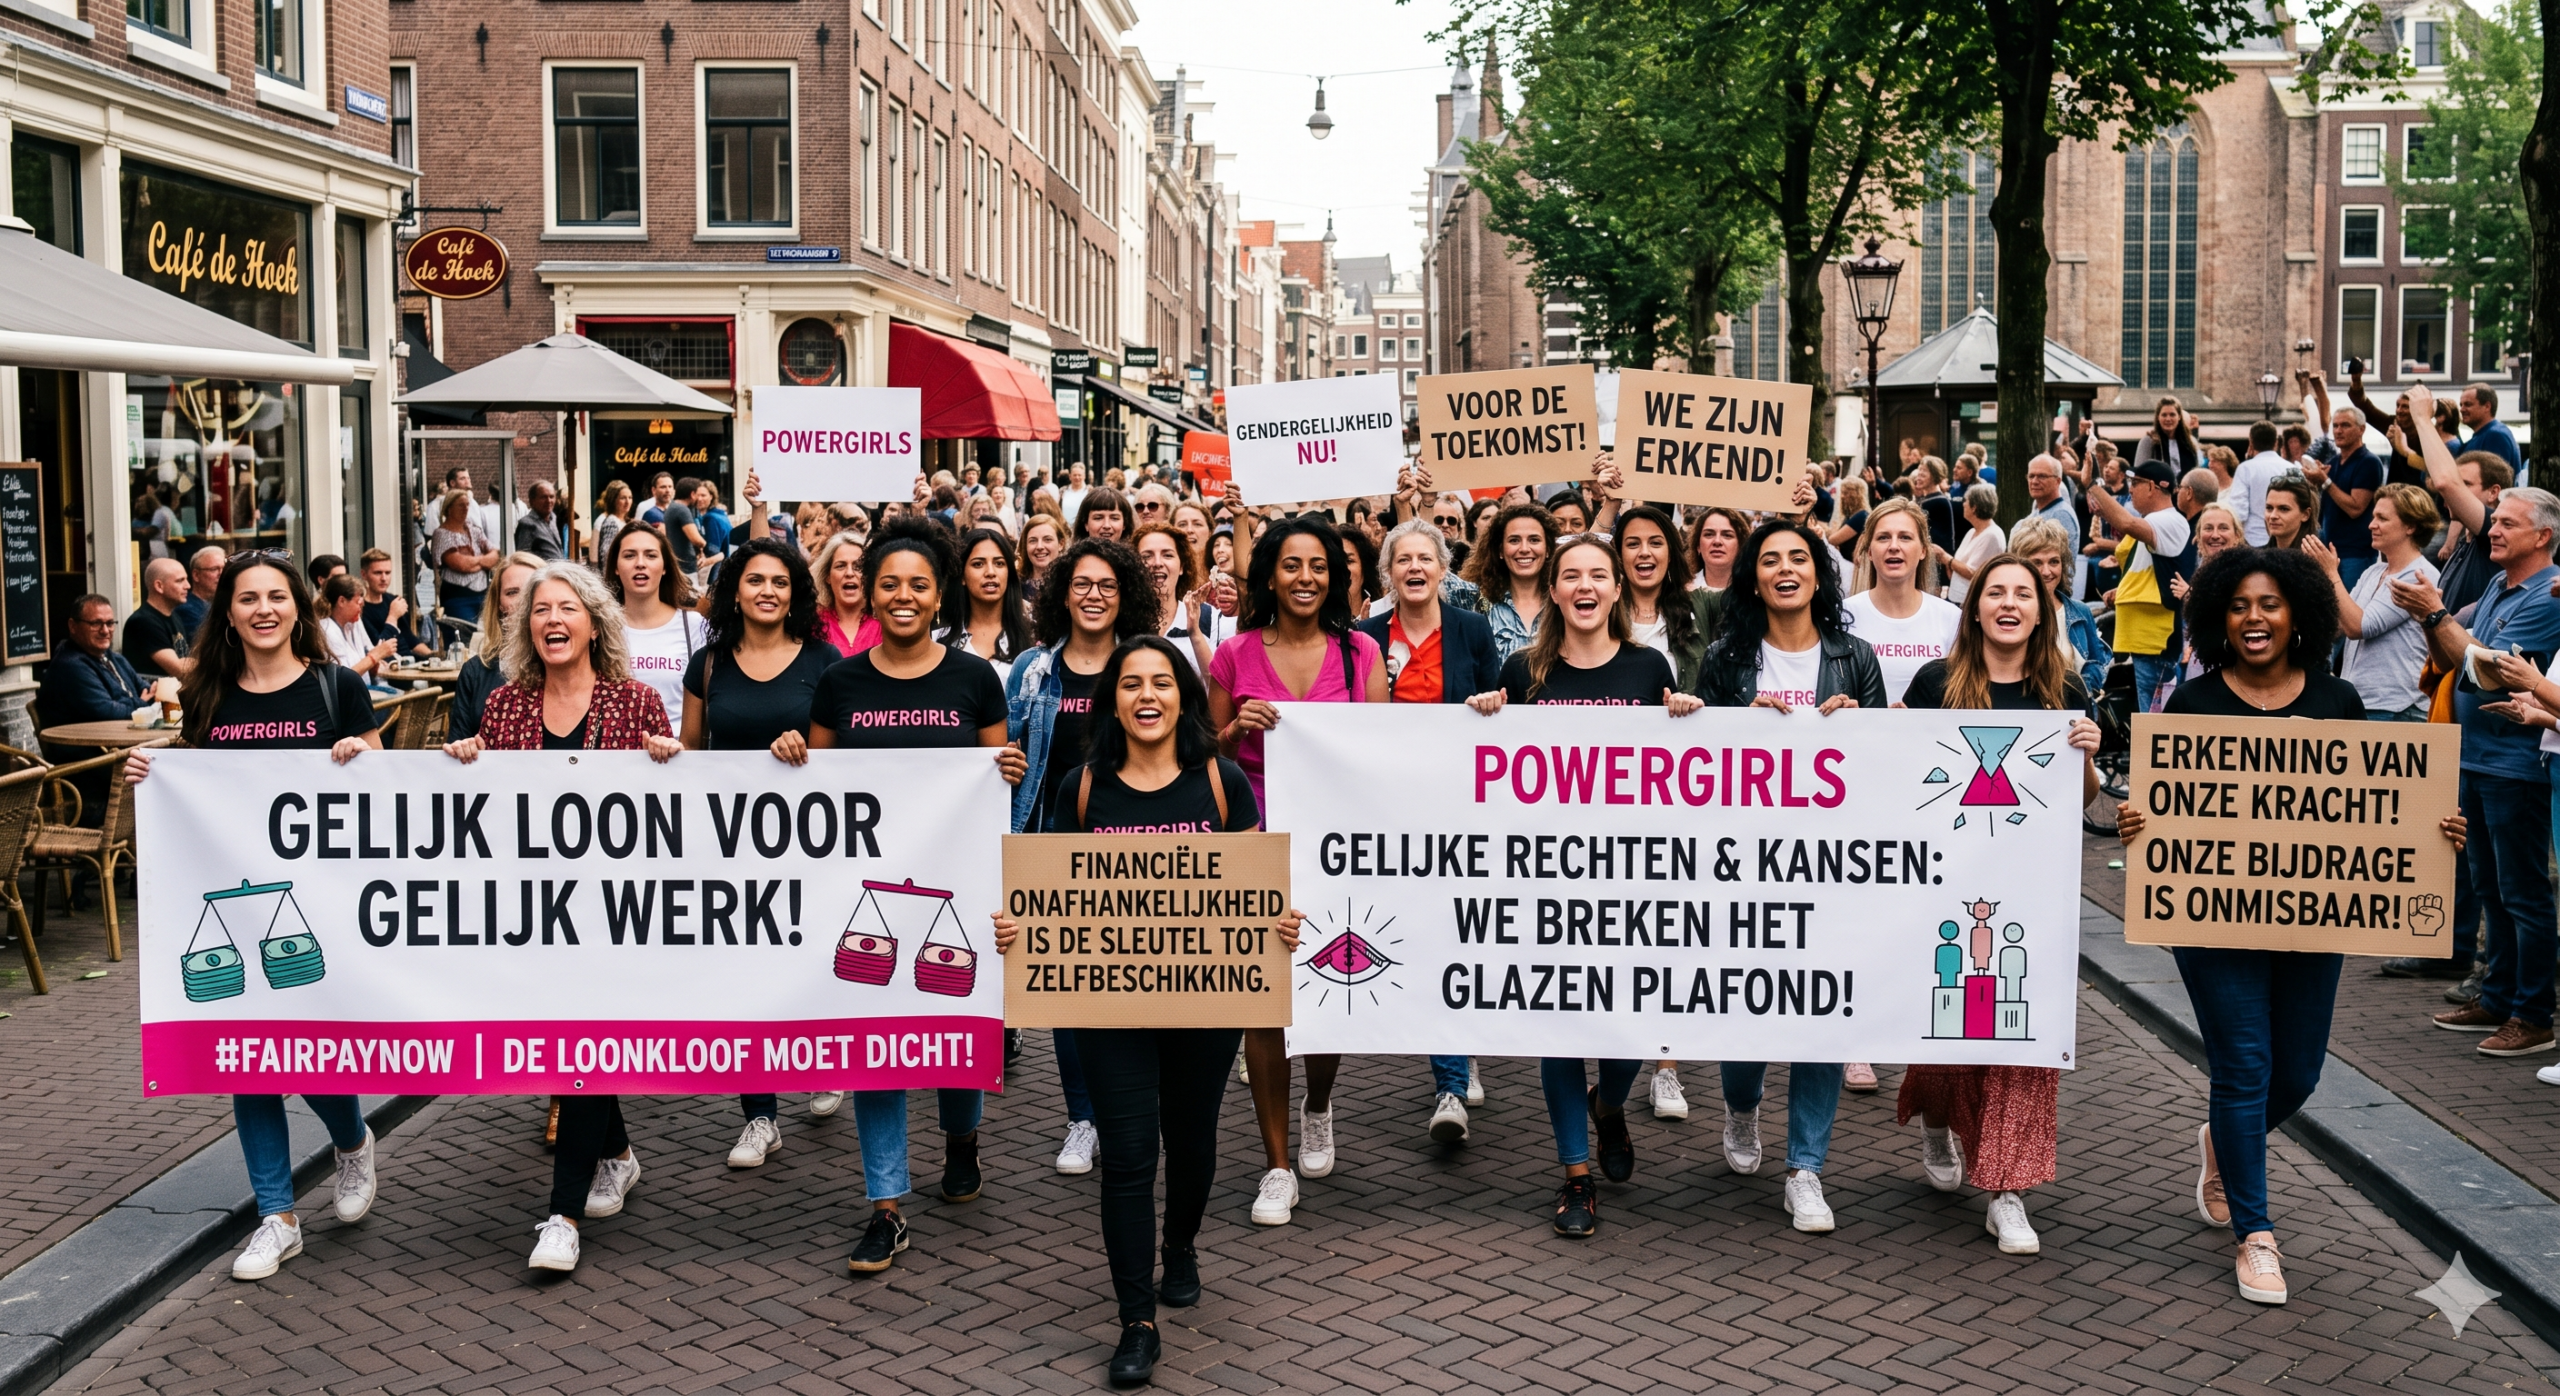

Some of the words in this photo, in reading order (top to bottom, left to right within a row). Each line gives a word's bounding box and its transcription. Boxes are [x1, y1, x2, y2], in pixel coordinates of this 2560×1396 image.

[148, 220, 205, 293] Café
[210, 233, 237, 285] de
[241, 238, 300, 295] Hoek
[437, 237, 475, 259] Café
[415, 259, 438, 280] de
[442, 258, 495, 281] Hoek
[1446, 388, 1523, 421] VOOR
[1532, 385, 1568, 416] DE
[1644, 390, 1695, 430] WE
[1705, 395, 1784, 437] ZIJN
[762, 430, 912, 455] POWERGIRLS
[1236, 412, 1393, 441] GENDERGELIJKHEID
[1430, 422, 1586, 461] TOEKOMST!
[615, 446, 648, 467] Café
[650, 447, 667, 463] de
[1297, 439, 1337, 465] NU!
[1635, 437, 1785, 485] ERKEND!
[1871, 643, 1942, 658] WERGIRLS
[211, 720, 317, 741] POWERGIRLS
[851, 709, 961, 729] POWERGIRLS
[2150, 733, 2348, 776] ERKENNING
[2360, 740, 2428, 779] VAN
[1474, 744, 1847, 809] POWERGIRLS
[2148, 780, 2239, 819] ONZE
[2251, 784, 2400, 826] KRACHT!
[268, 792, 493, 860] GELIJK
[516, 792, 683, 860] LOON
[706, 791, 882, 859] VOOR
[1071, 845, 1222, 880] FINANCIËLE
[1320, 832, 1489, 878] GELIJKE
[1506, 834, 1696, 881] RECHTEN
[1713, 837, 1742, 882] &
[1758, 838, 1943, 885] KANSEN:
[2146, 837, 2236, 876] ONZE
[2247, 841, 2416, 884] BIJDRAGE
[358, 879, 580, 948] GELIJK
[601, 879, 803, 947] WERK!
[1009, 889, 1284, 918] ONAFHANKELIJKHEID
[1453, 897, 1519, 945] WE
[1536, 898, 1711, 948] BREKEN
[1729, 901, 1815, 949] HET
[2144, 884, 2175, 921] IS
[2186, 886, 2401, 930] ONMISBAAR!
[1027, 926, 1050, 955] IS
[1059, 926, 1092, 955] DE
[1100, 926, 1213, 955] SLEUTEL
[1220, 926, 1269, 956] TOT
[1026, 964, 1271, 993] ZELFBESCHIKKING.
[1442, 962, 1613, 1012] GLAZEN
[1633, 966, 1853, 1018] PLAFOND!
[215, 1038, 455, 1074] #FAIRPAYNOW
[504, 1038, 546, 1073] DE
[557, 1037, 752, 1073] LOONKLOOF
[763, 1035, 854, 1072] MOET
[866, 1032, 973, 1069] DICHT!
